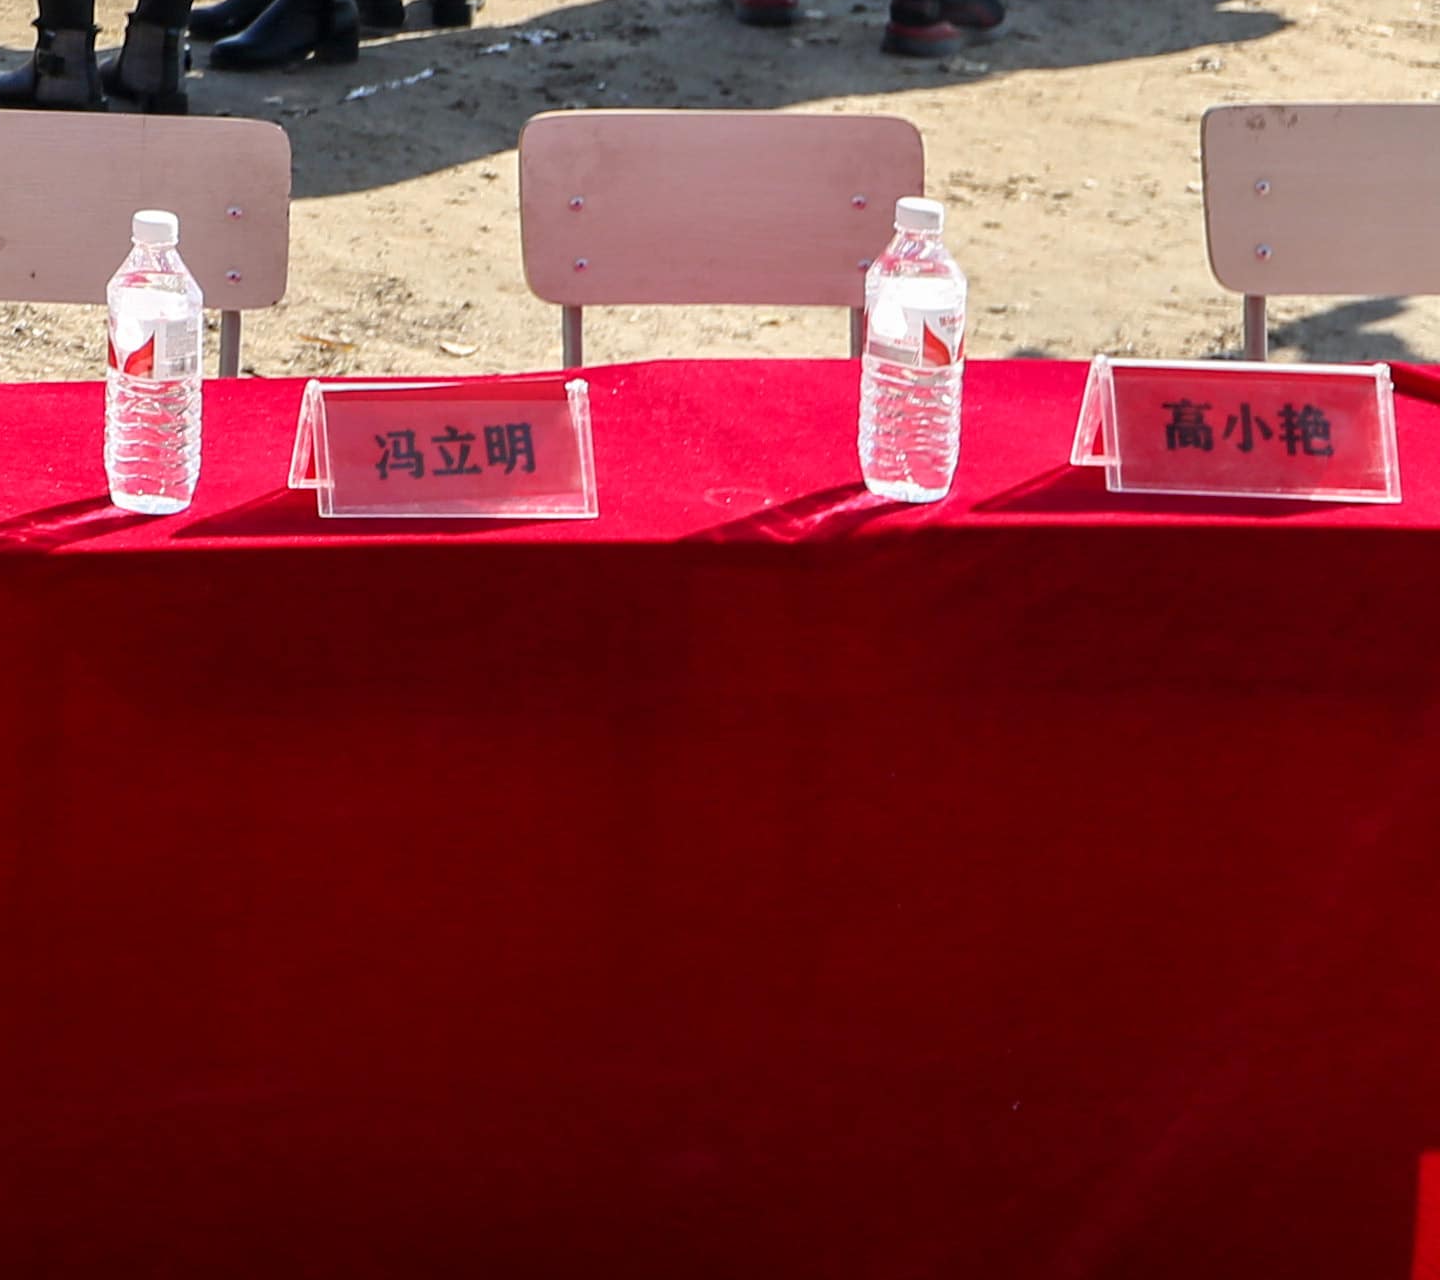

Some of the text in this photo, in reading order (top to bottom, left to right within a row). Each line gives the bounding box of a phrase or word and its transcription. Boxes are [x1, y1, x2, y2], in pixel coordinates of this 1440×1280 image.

[375, 422, 536, 480] 冯立明
[1162, 397, 1334, 456] 高小艳
